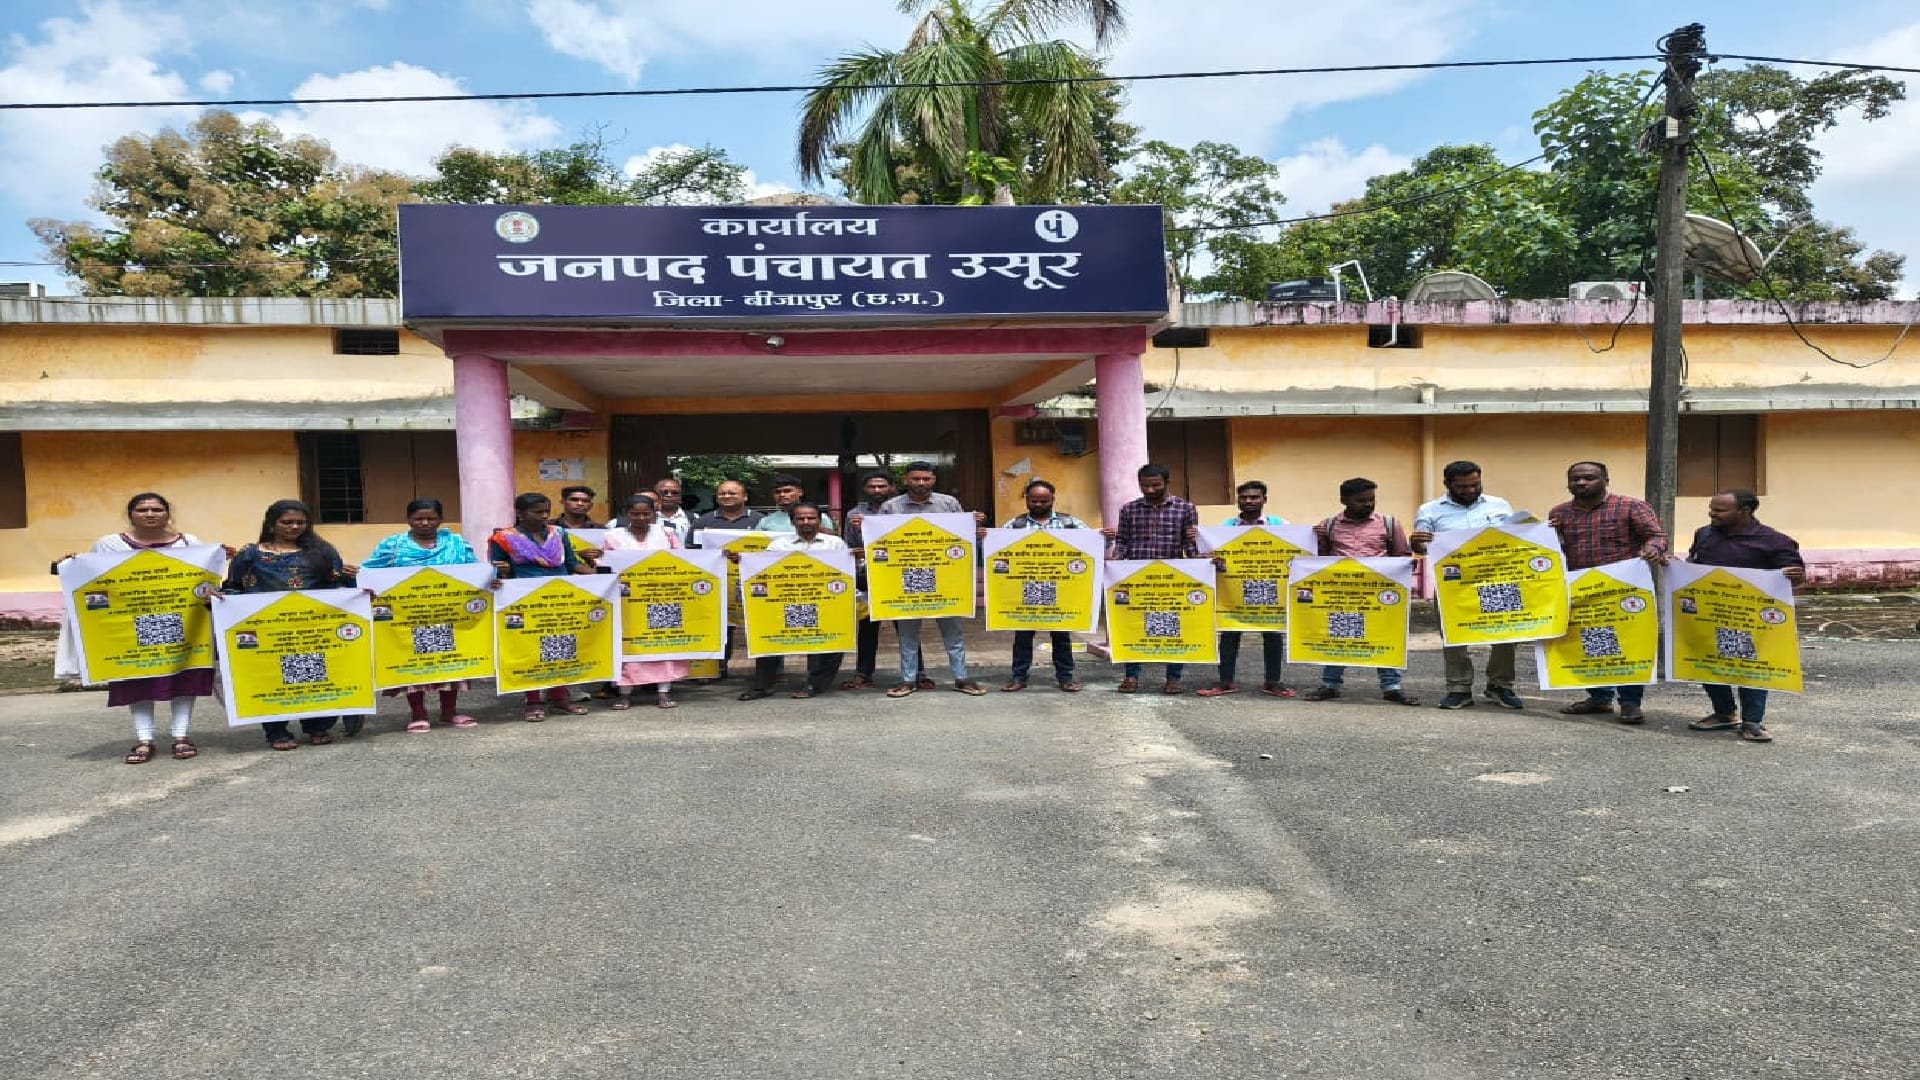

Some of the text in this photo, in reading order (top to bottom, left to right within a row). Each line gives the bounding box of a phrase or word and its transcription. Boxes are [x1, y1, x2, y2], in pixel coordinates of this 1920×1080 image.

[700, 212, 880, 237] कार्यालय
[496, 243, 1082, 290] जनपद पंचायत उसूर
[653, 290, 945, 310] जिला- बीजापुर (छ.ग.)
